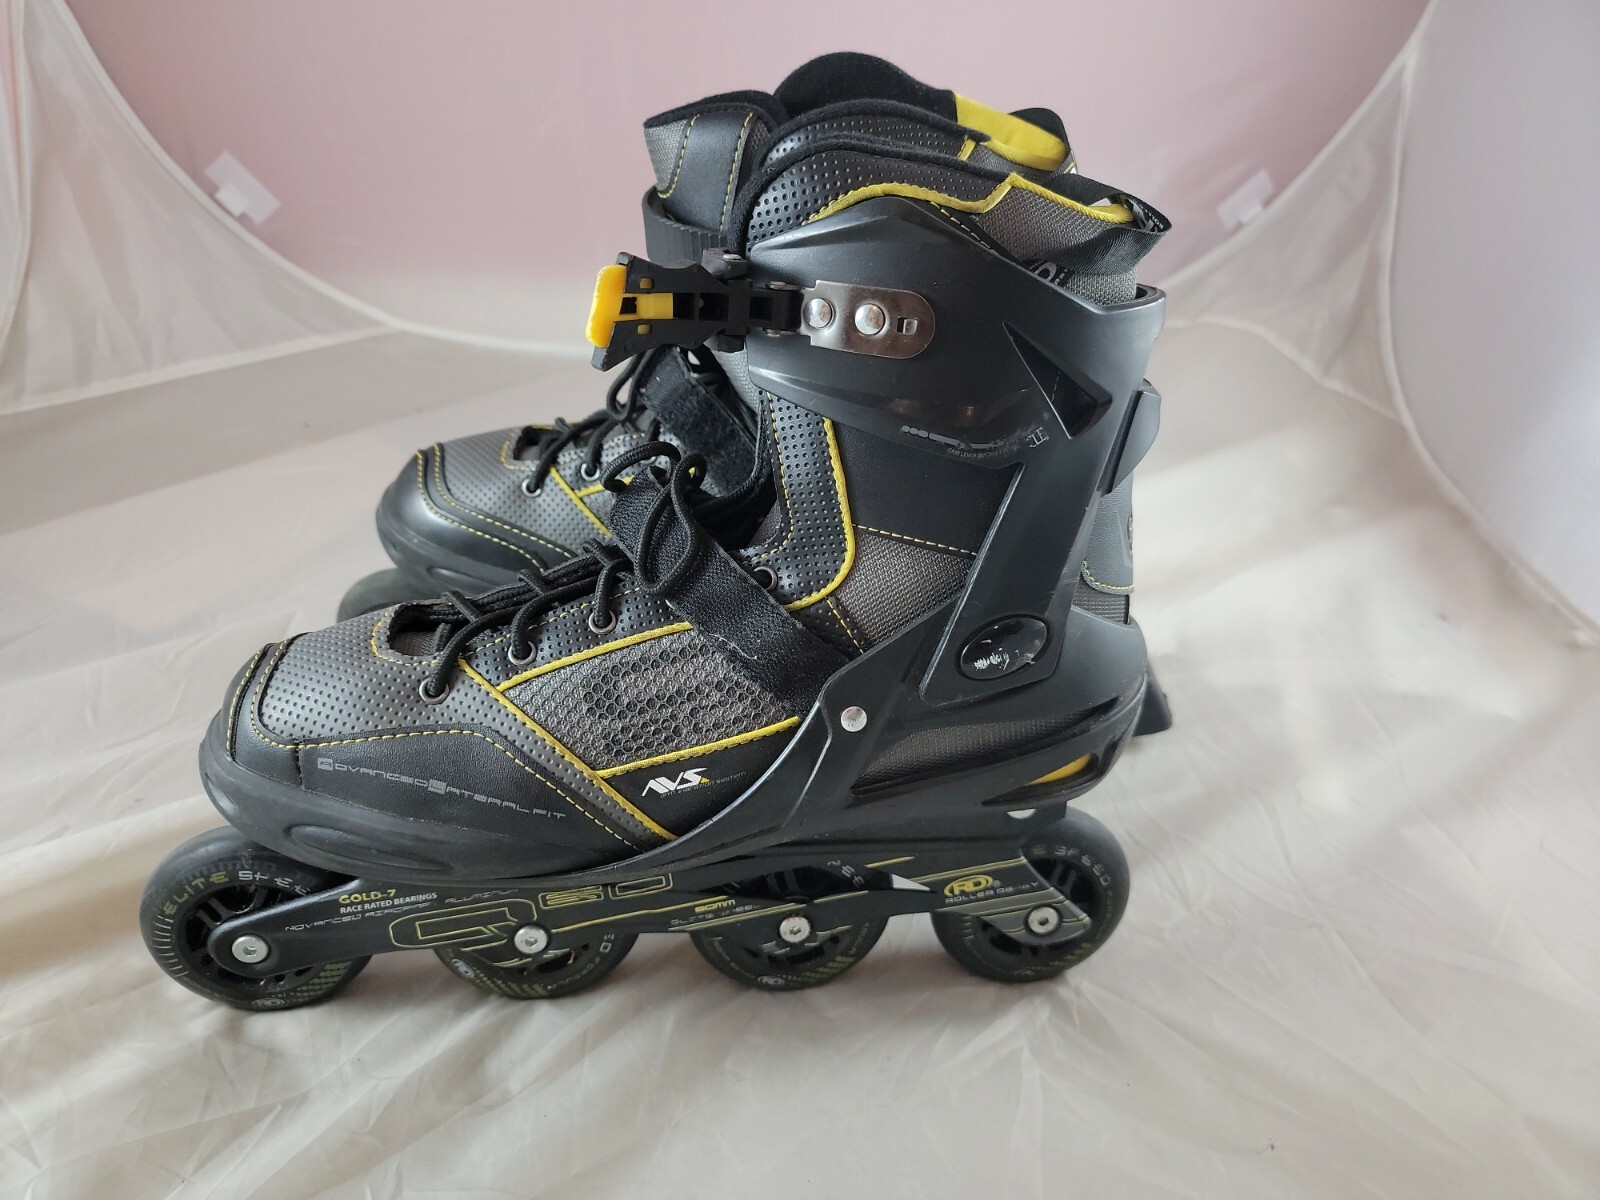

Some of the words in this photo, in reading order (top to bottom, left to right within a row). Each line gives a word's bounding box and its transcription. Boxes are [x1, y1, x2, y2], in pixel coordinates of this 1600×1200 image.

[532, 807, 566, 818] FIT
[163, 870, 229, 915] ELITE
[996, 881, 1039, 894] DEY
[338, 888, 397, 905] GOLD-7
[340, 904, 364, 914] RACE
[364, 899, 392, 912] RATED
[393, 892, 438, 906] BEARINGS
